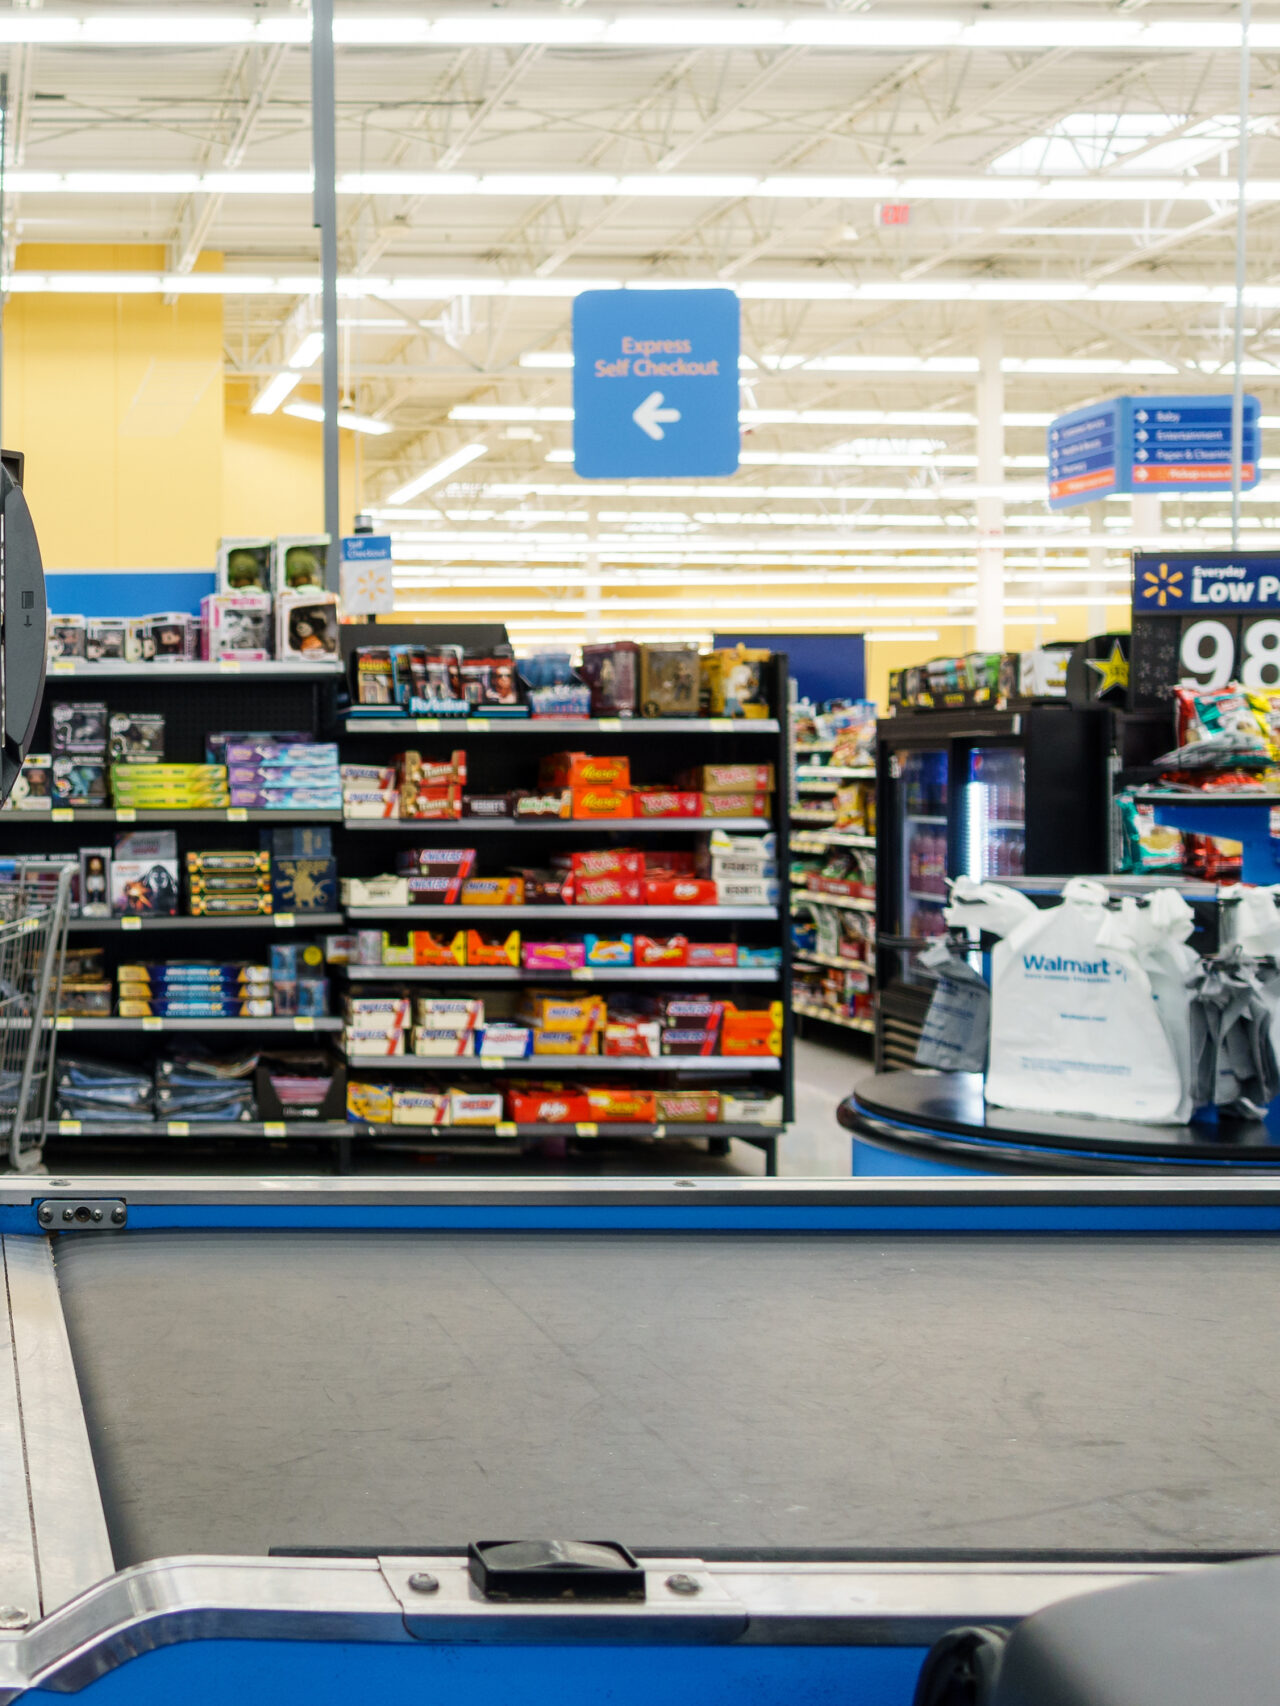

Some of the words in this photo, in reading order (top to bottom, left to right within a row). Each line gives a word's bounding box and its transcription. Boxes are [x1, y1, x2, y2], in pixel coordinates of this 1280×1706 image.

[622, 336, 692, 357] Express
[594, 358, 630, 378] Self
[633, 357, 719, 377] Checkout
[1192, 565, 1247, 579] Everyday
[1191, 578, 1255, 603] Low
[1258, 576, 1280, 602] P
[1023, 955, 1110, 976] Walmart
